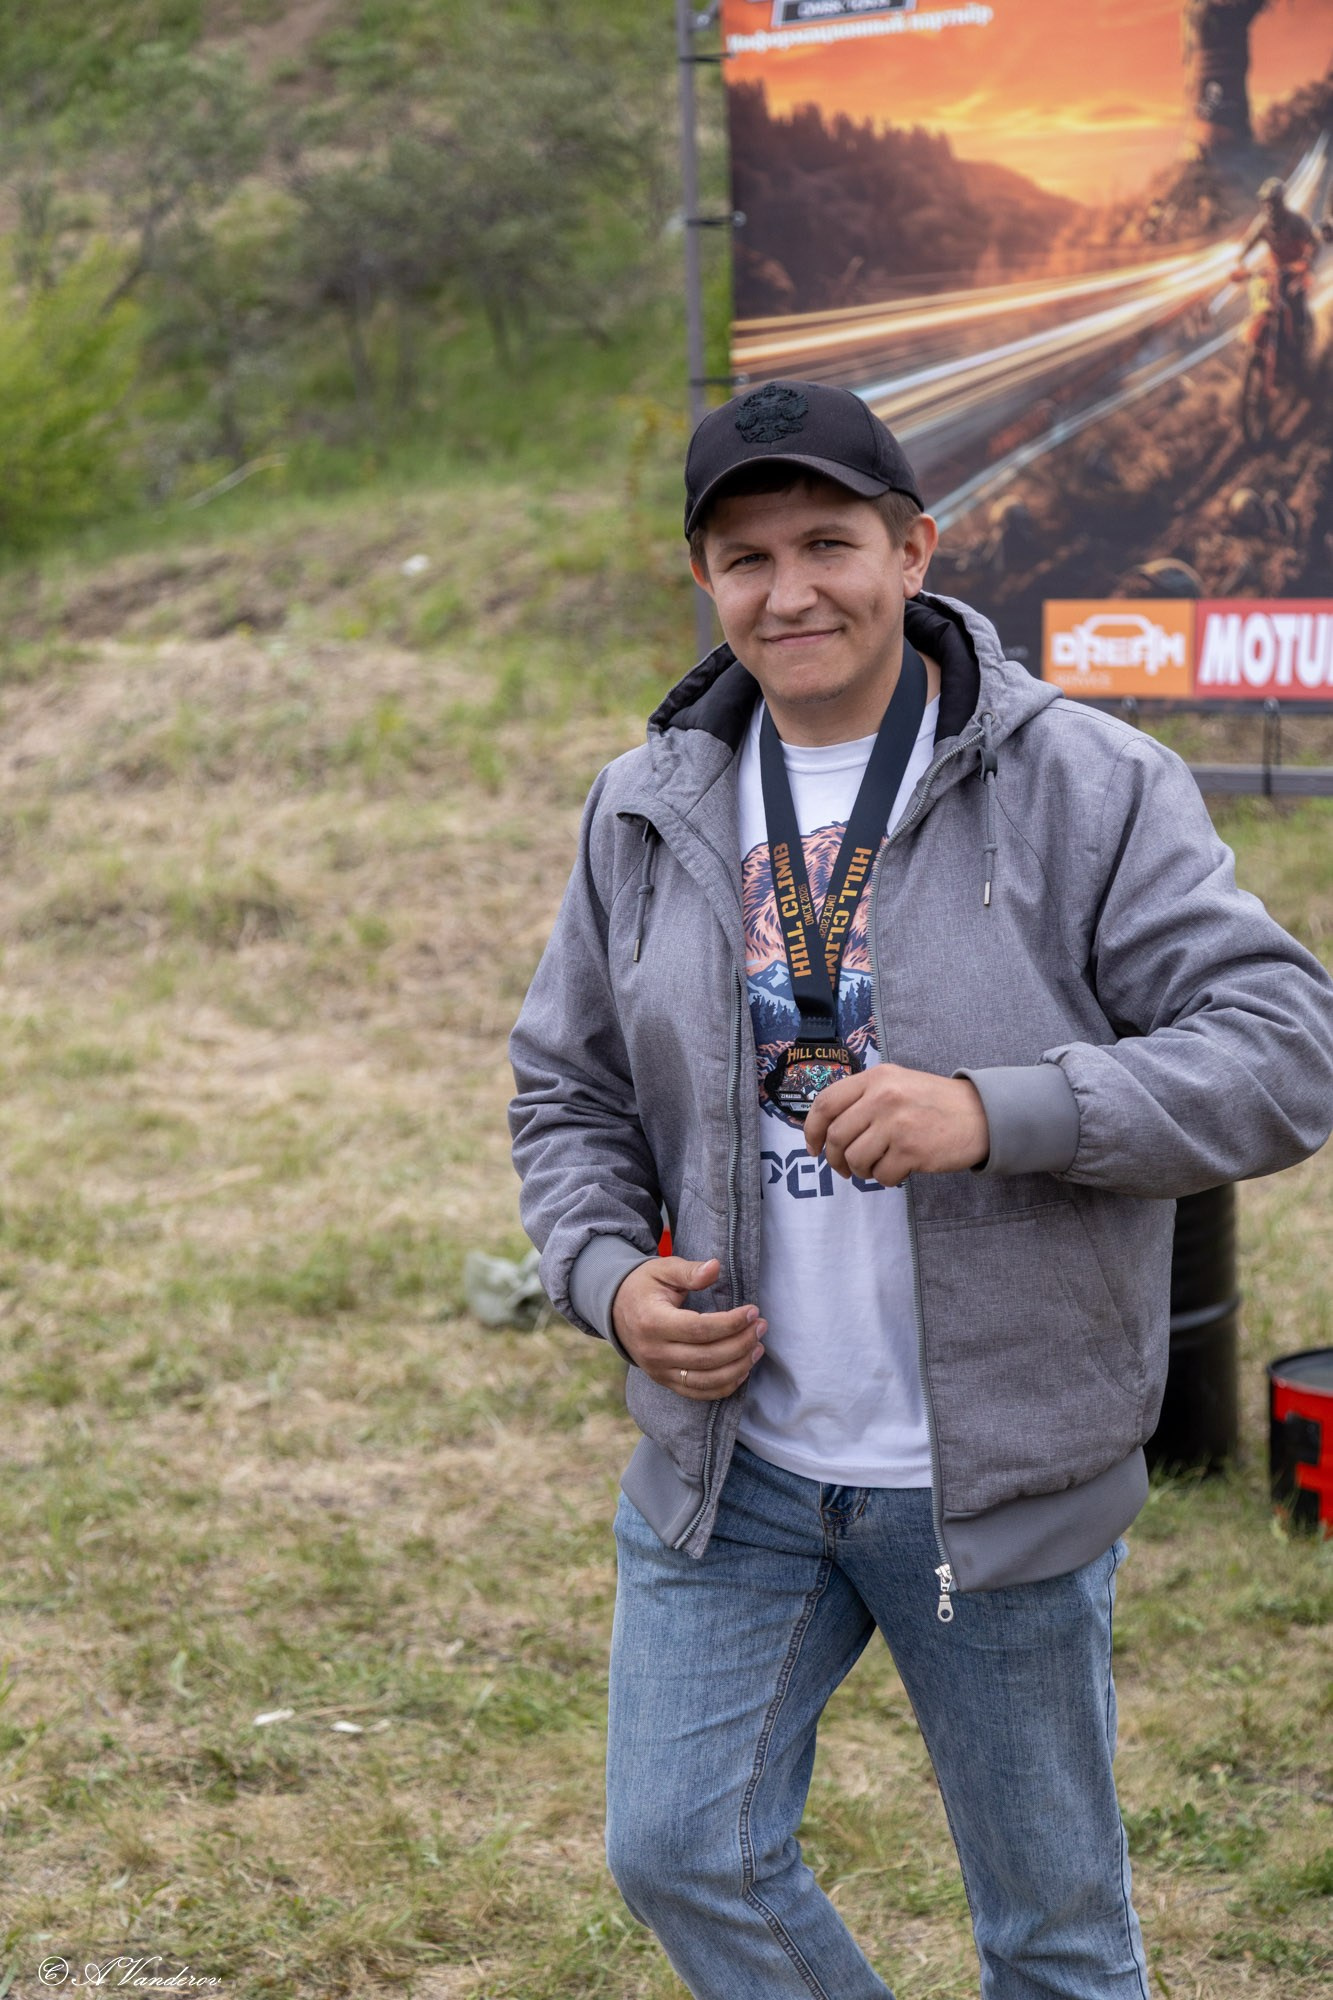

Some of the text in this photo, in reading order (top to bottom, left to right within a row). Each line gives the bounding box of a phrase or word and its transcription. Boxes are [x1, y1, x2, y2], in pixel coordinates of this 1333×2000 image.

[839, 847, 873, 904] HILL
[773, 842, 812, 978] HILL CLIMB
[787, 1047, 850, 1064] HILL CLIMB
